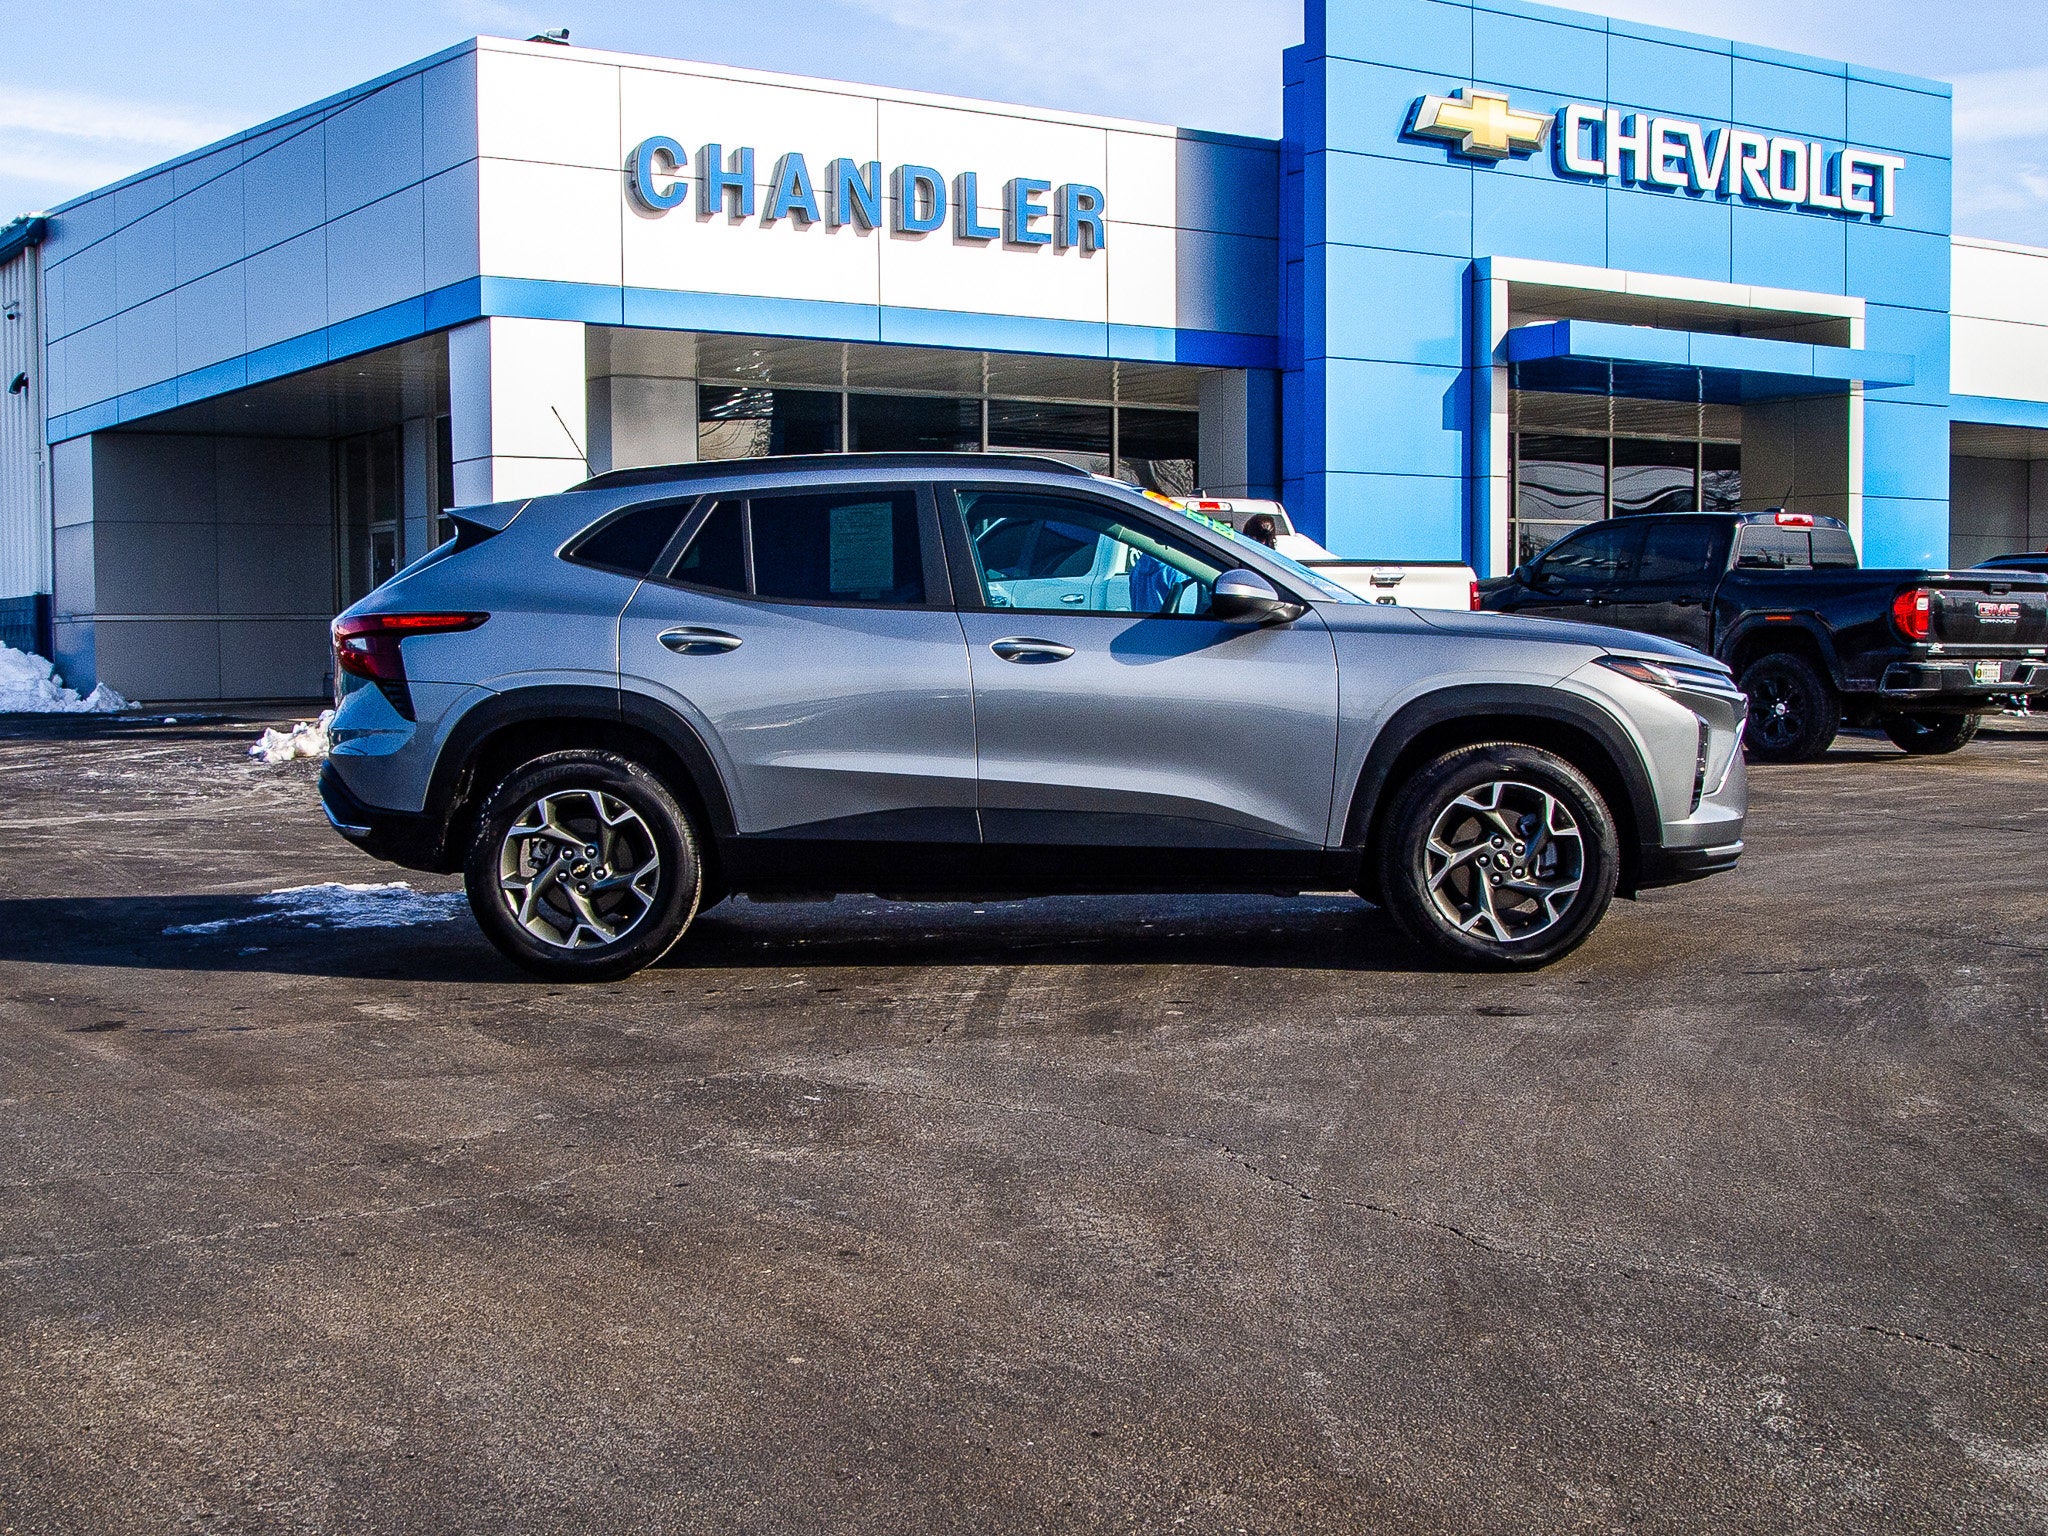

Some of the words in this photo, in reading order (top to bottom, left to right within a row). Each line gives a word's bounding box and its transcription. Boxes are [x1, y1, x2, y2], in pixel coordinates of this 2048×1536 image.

[627, 135, 1107, 252] CHANDLER
[1559, 102, 1906, 218] CHEVROLET
[1978, 603, 2020, 616] GMC
